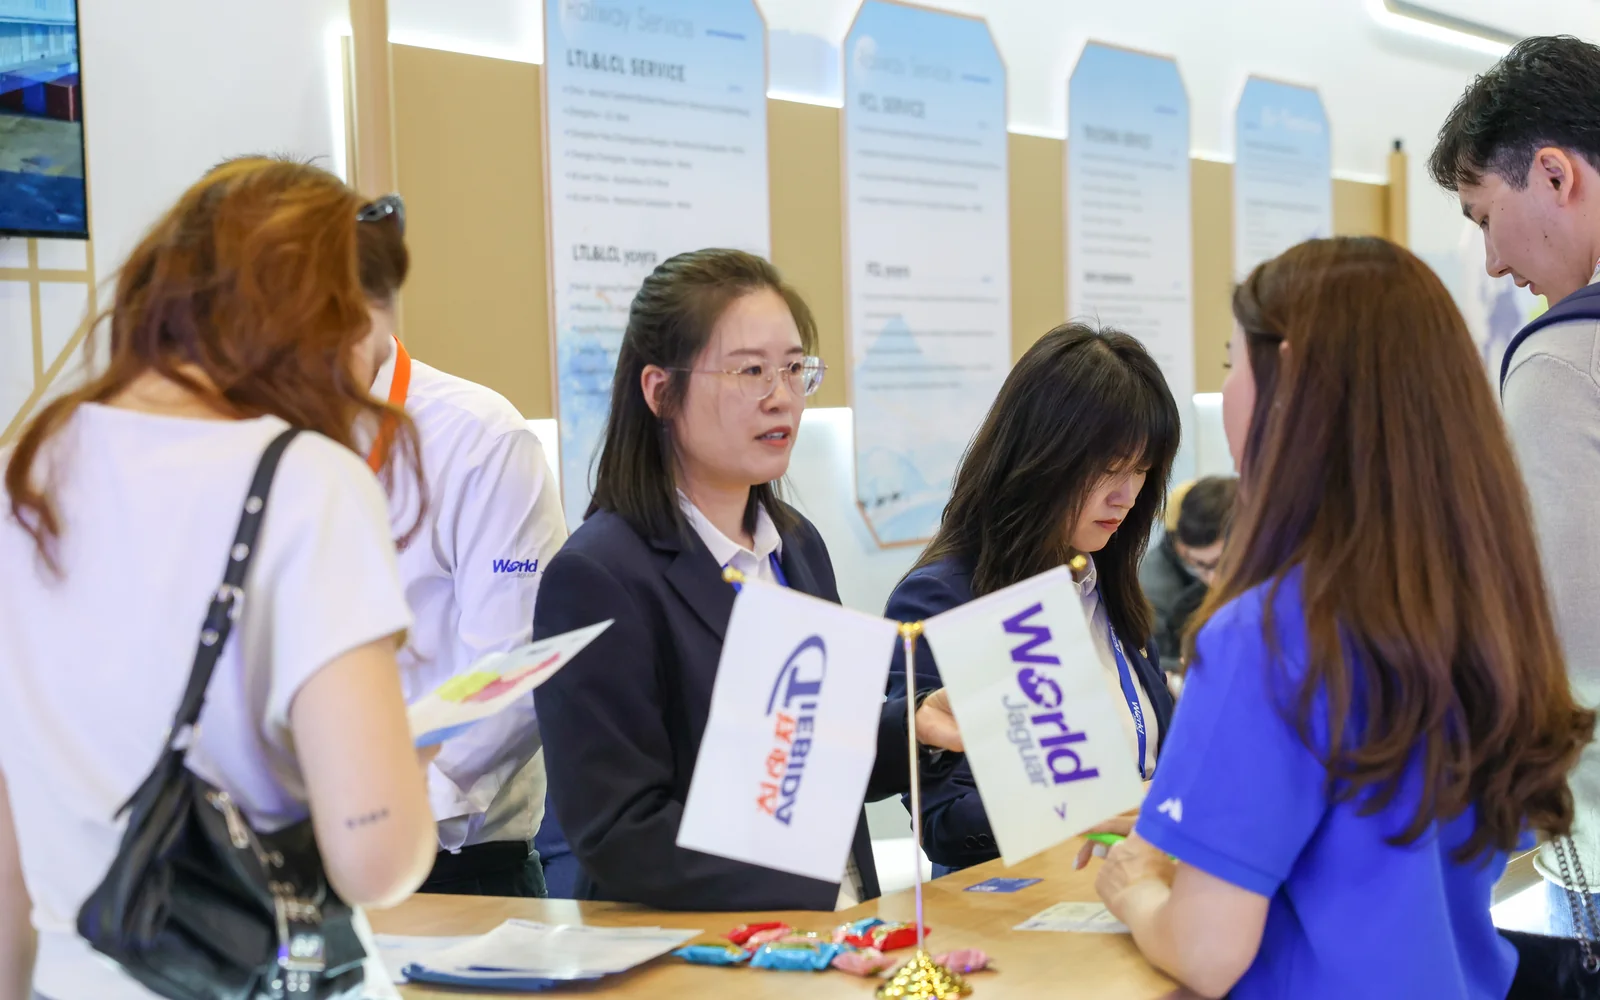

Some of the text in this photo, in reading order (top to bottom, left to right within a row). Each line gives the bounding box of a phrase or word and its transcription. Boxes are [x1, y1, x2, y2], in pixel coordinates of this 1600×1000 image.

[631, 57, 687, 82] SERVICE
[492, 559, 539, 573] World
[1001, 601, 1101, 785] World
[1131, 700, 1145, 735] World
[1002, 693, 1049, 788] Jaguar
